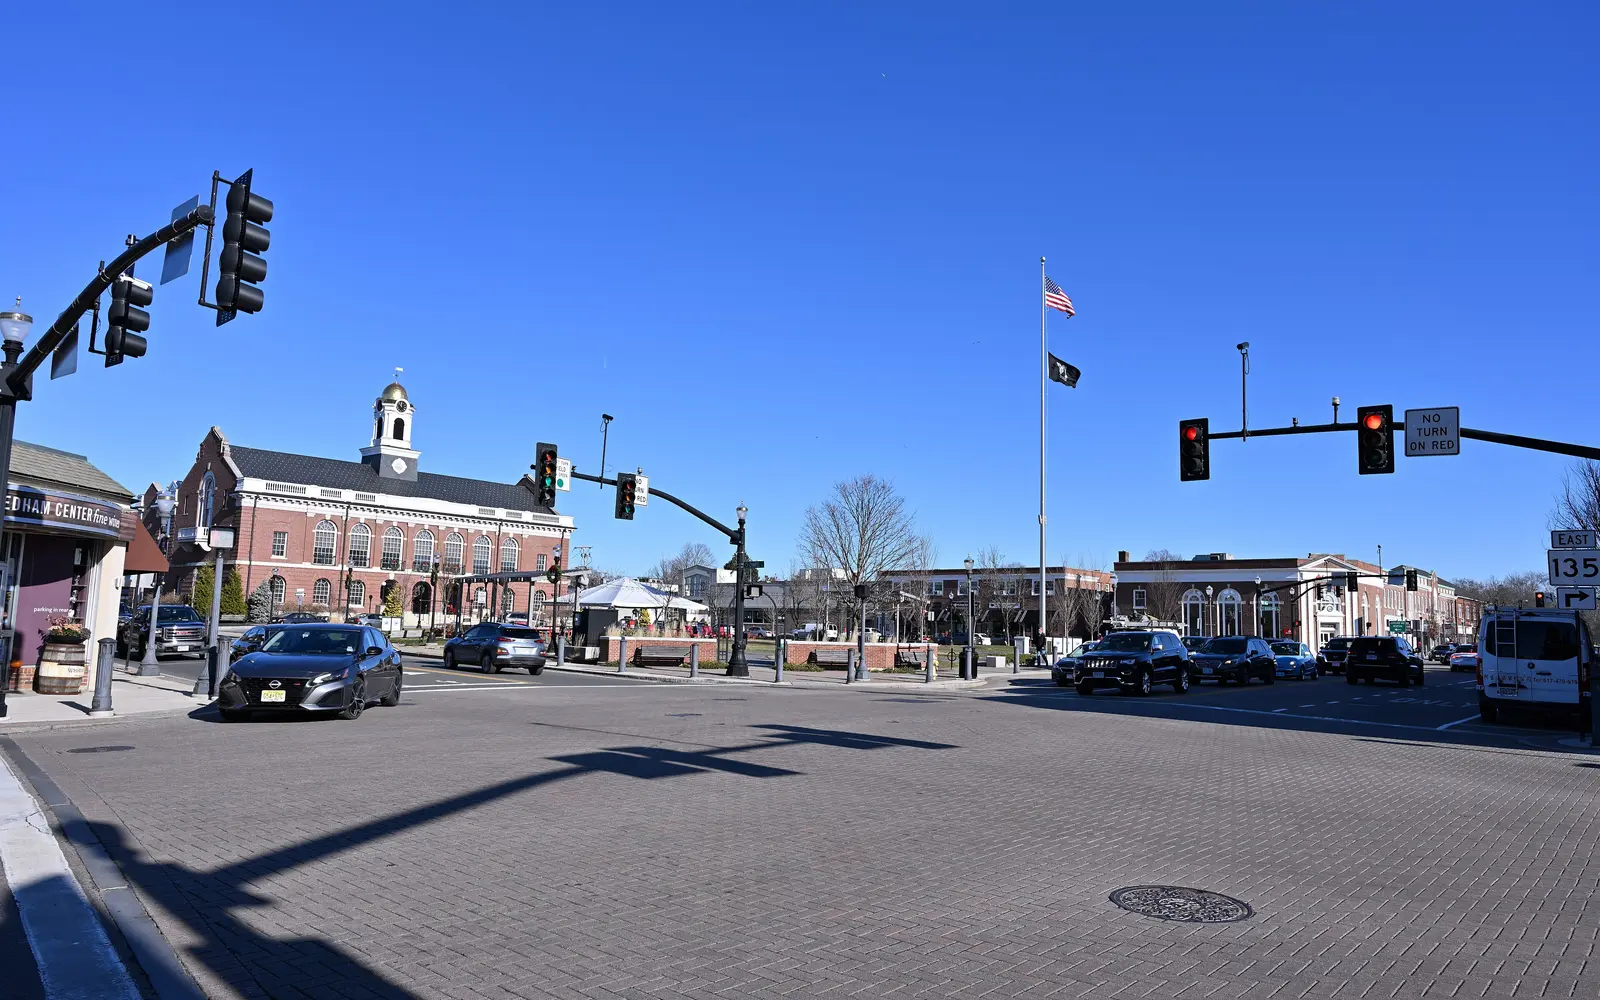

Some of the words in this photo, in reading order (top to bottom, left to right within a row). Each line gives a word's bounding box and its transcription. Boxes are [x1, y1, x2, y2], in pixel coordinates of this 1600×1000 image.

[1422, 414, 1441, 423] NO
[1417, 427, 1448, 437] TURN
[1410, 441, 1426, 451] ON
[1431, 440, 1455, 450] RED
[636, 495, 646, 503] RED
[5, 495, 51, 515] EDHAM
[55, 502, 93, 522] CENTER
[93, 508, 108, 525] fine
[1558, 533, 1589, 546] EAST
[1552, 557, 1599, 578] 135
[33, 606, 53, 614] parking
